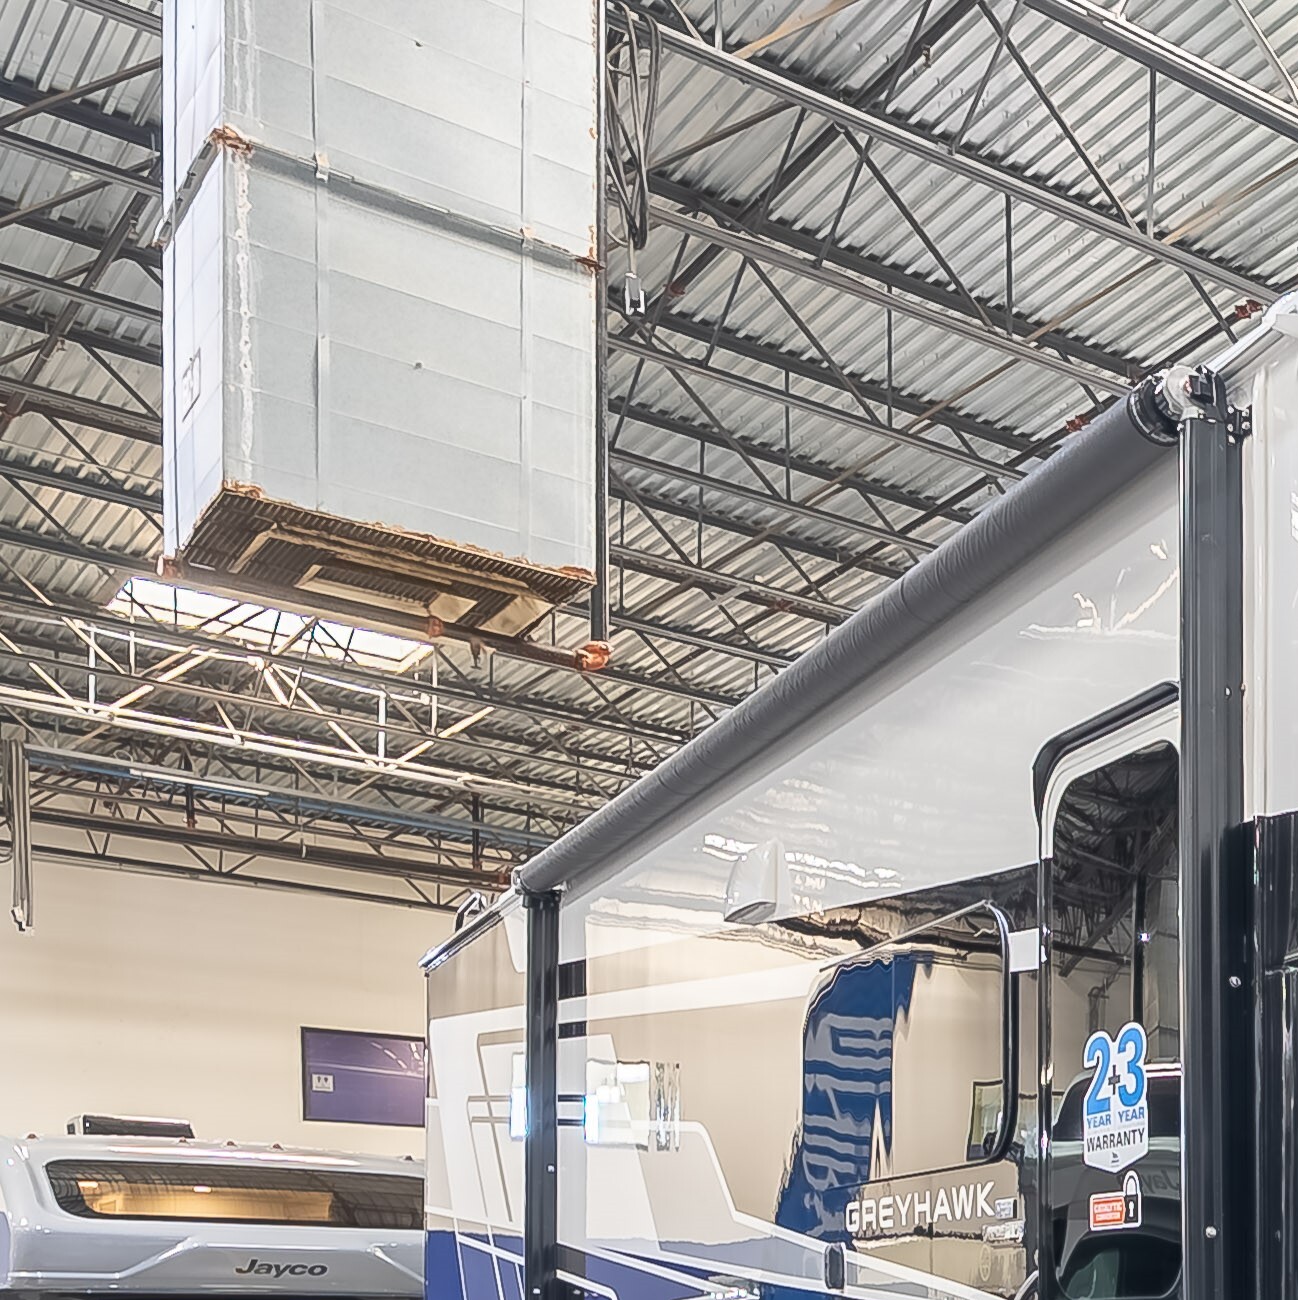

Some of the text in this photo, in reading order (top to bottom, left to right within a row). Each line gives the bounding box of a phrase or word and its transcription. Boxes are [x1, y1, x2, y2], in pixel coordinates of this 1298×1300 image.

[1087, 1106, 1145, 1130] YEAR YEAR
[1086, 1127, 1146, 1153] WARRANTY
[845, 1180, 996, 1233] GREYHAWK
[235, 1258, 328, 1279] Jayco
